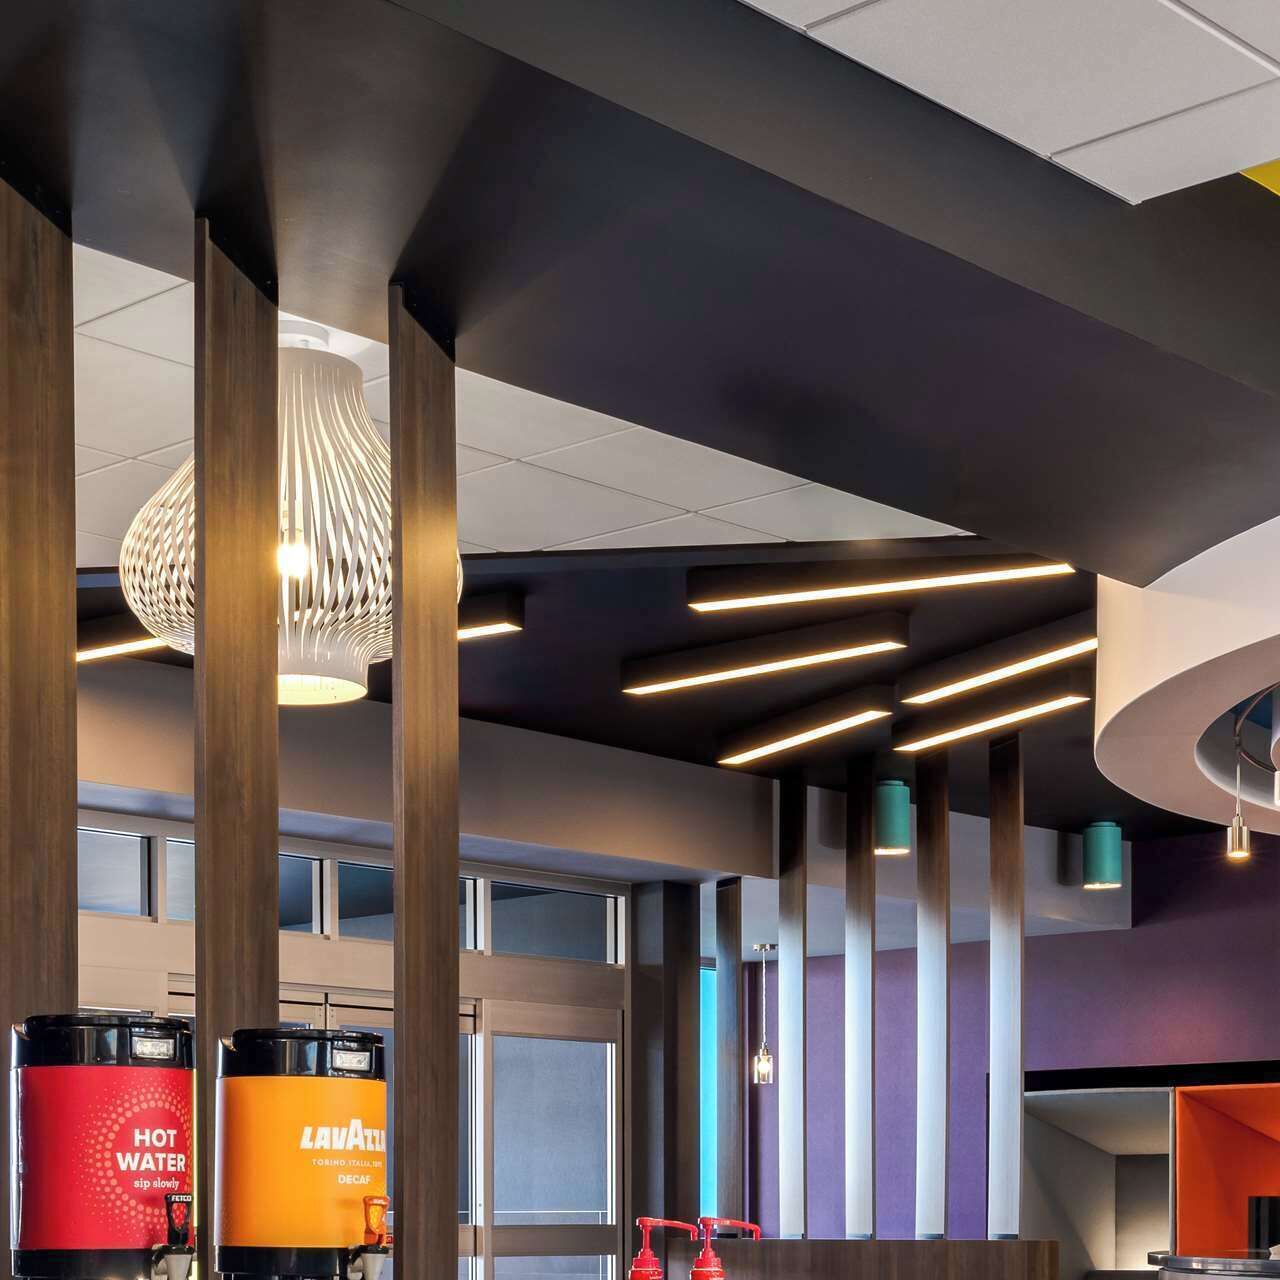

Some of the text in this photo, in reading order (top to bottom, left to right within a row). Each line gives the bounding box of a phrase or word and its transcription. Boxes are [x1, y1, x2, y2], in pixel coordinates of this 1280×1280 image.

[133, 1128, 177, 1148] HOT
[116, 1152, 186, 1172] WATER
[133, 1177, 180, 1190] sip slowly
[338, 1174, 372, 1184] DECAF
